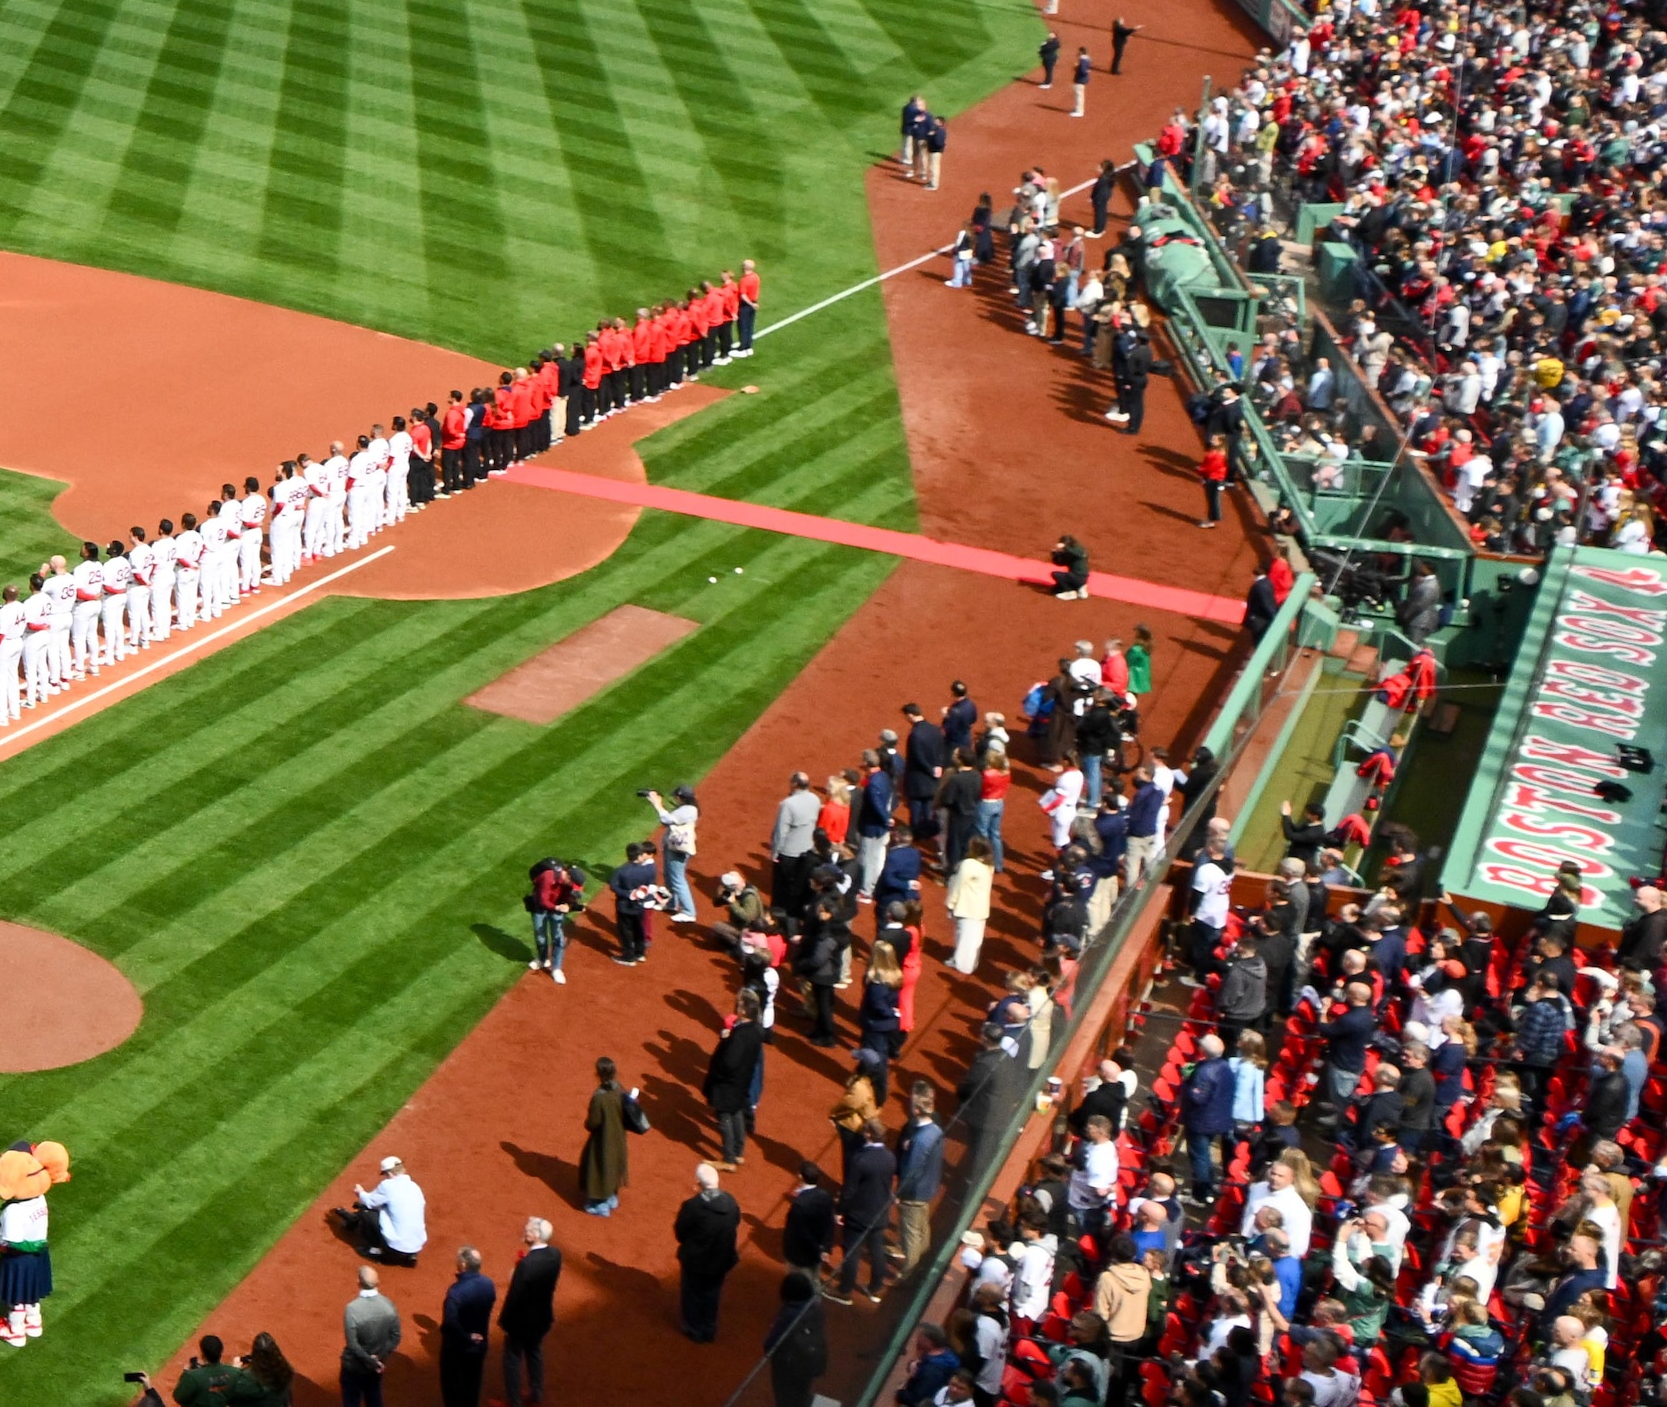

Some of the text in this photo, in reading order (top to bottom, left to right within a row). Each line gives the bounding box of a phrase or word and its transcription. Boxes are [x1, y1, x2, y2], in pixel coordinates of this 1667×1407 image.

[1478, 589, 1667, 909] BOSTON RED SOX
